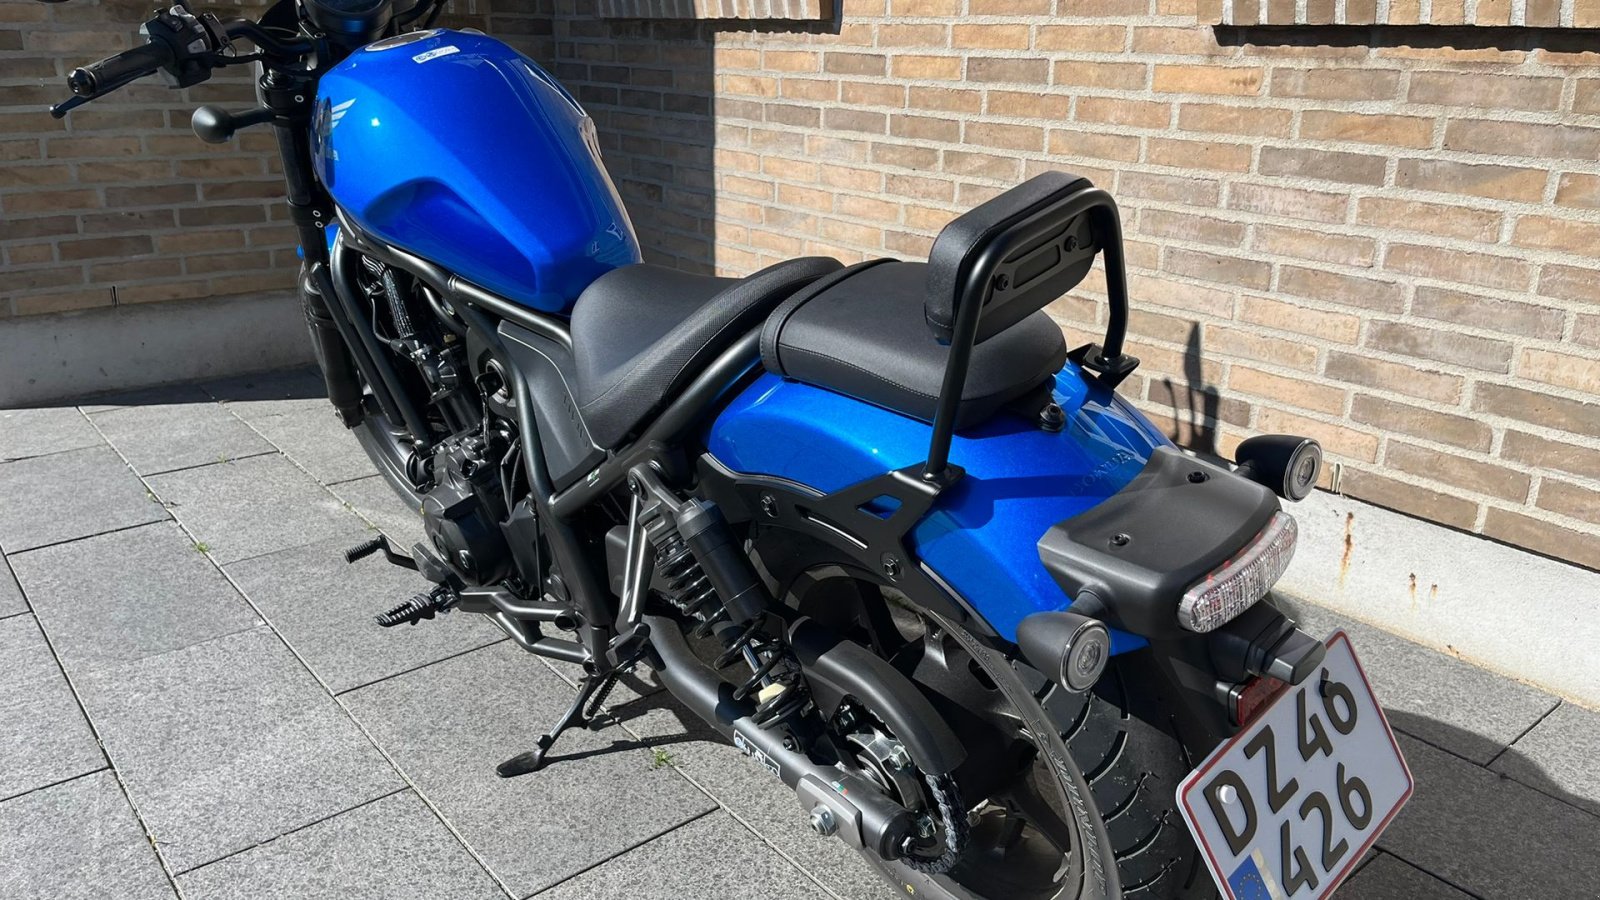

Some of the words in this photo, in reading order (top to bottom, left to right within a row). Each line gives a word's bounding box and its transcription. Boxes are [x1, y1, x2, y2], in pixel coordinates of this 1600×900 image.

[1202, 724, 1299, 857] DZ
[1296, 667, 1358, 762] 46
[1280, 761, 1373, 897] 426
